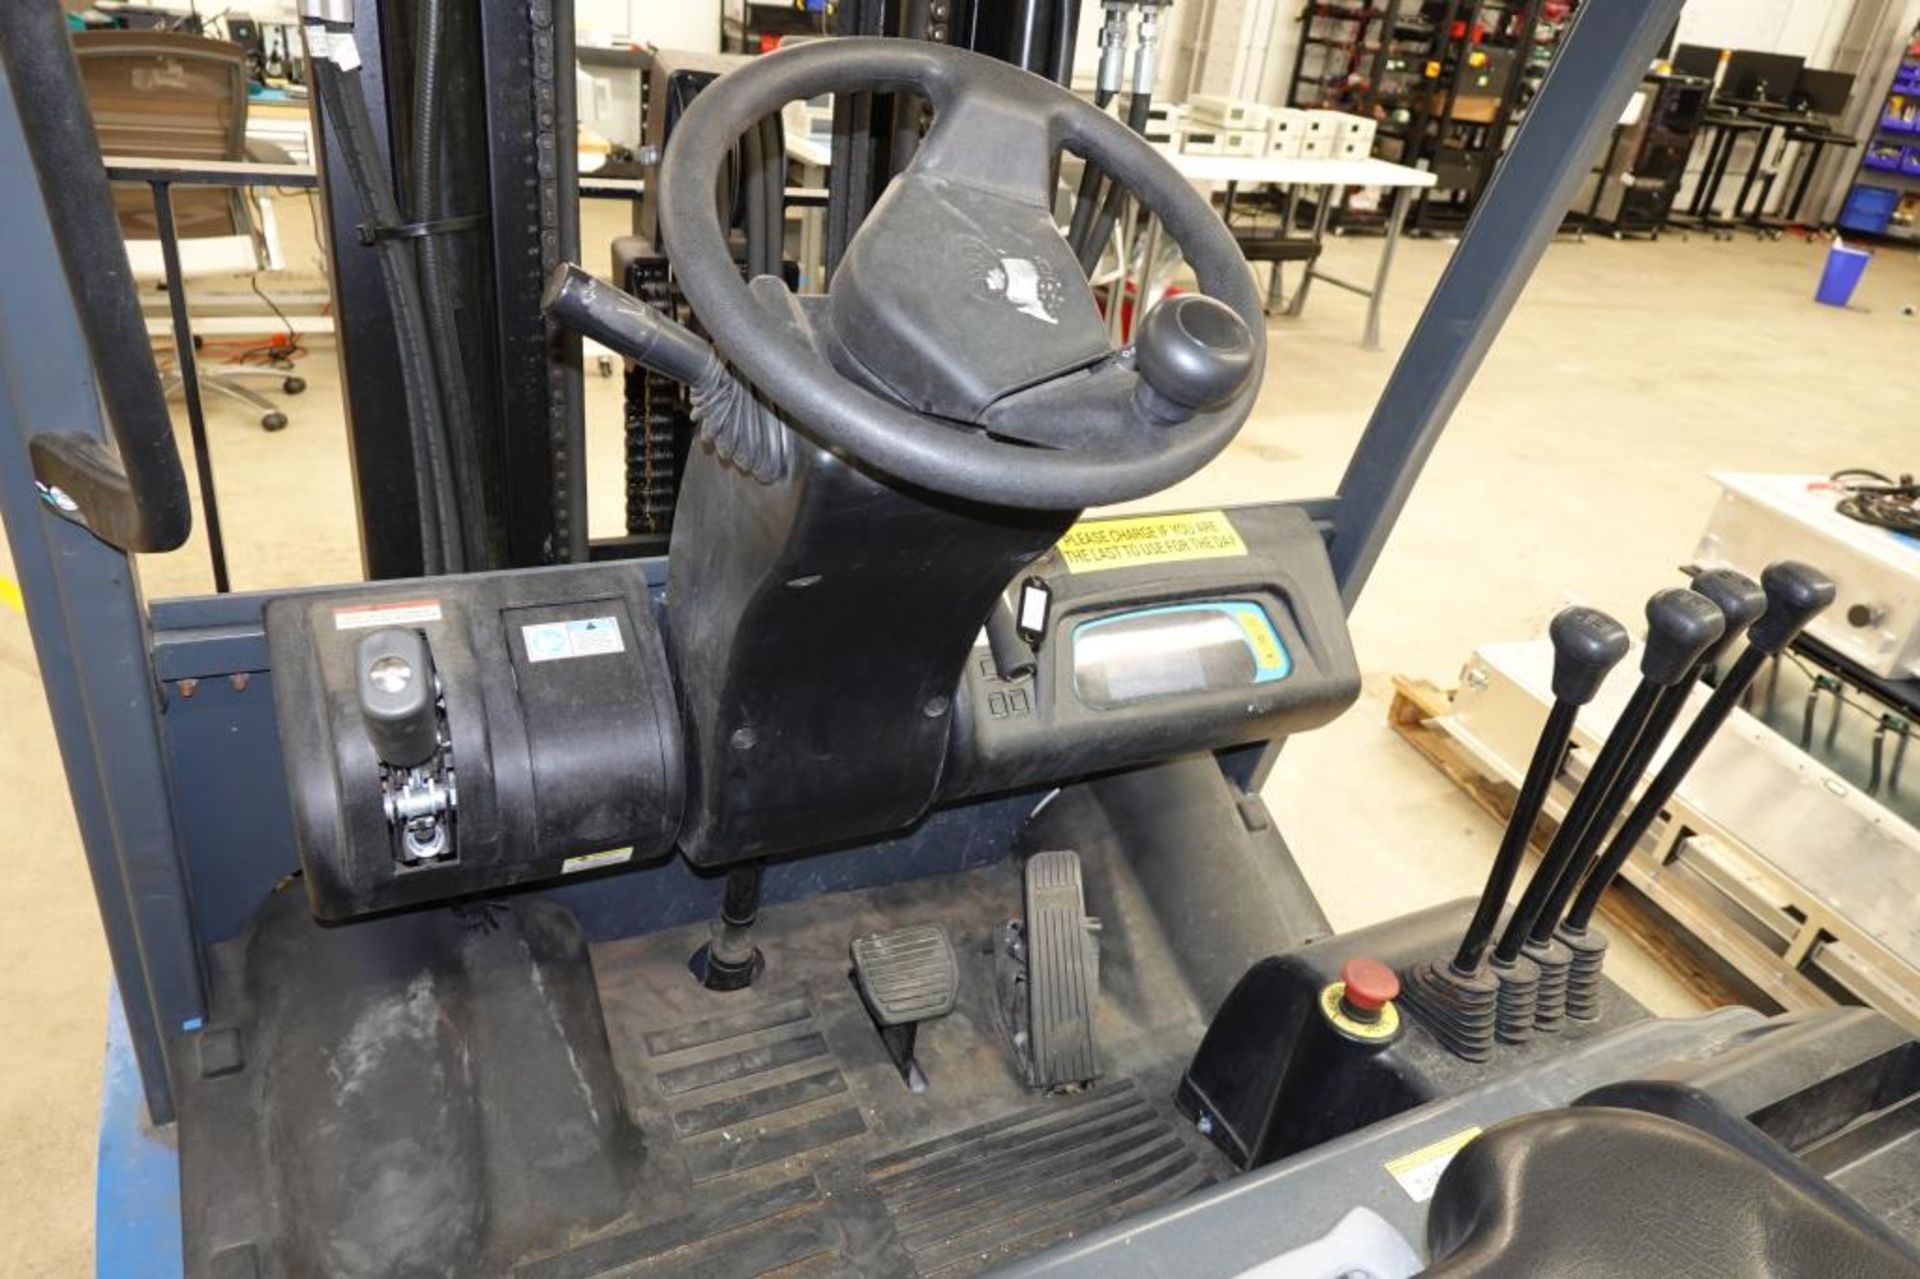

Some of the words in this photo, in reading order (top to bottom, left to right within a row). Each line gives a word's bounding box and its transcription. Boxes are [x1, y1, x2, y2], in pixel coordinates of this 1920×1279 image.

[1063, 530, 1109, 547] PLEASE
[1109, 526, 1156, 542] CHARGE
[1158, 525, 1167, 538] IF
[1169, 523, 1194, 536] YOU
[1198, 521, 1219, 533] ARE
[1063, 549, 1093, 564] THE
[1093, 545, 1121, 561] LAST
[1121, 543, 1141, 558] TO
[1142, 541, 1165, 556] USE
[1165, 539, 1190, 554] FOR
[1190, 537, 1215, 551] THE
[1217, 535, 1238, 549] DAY
